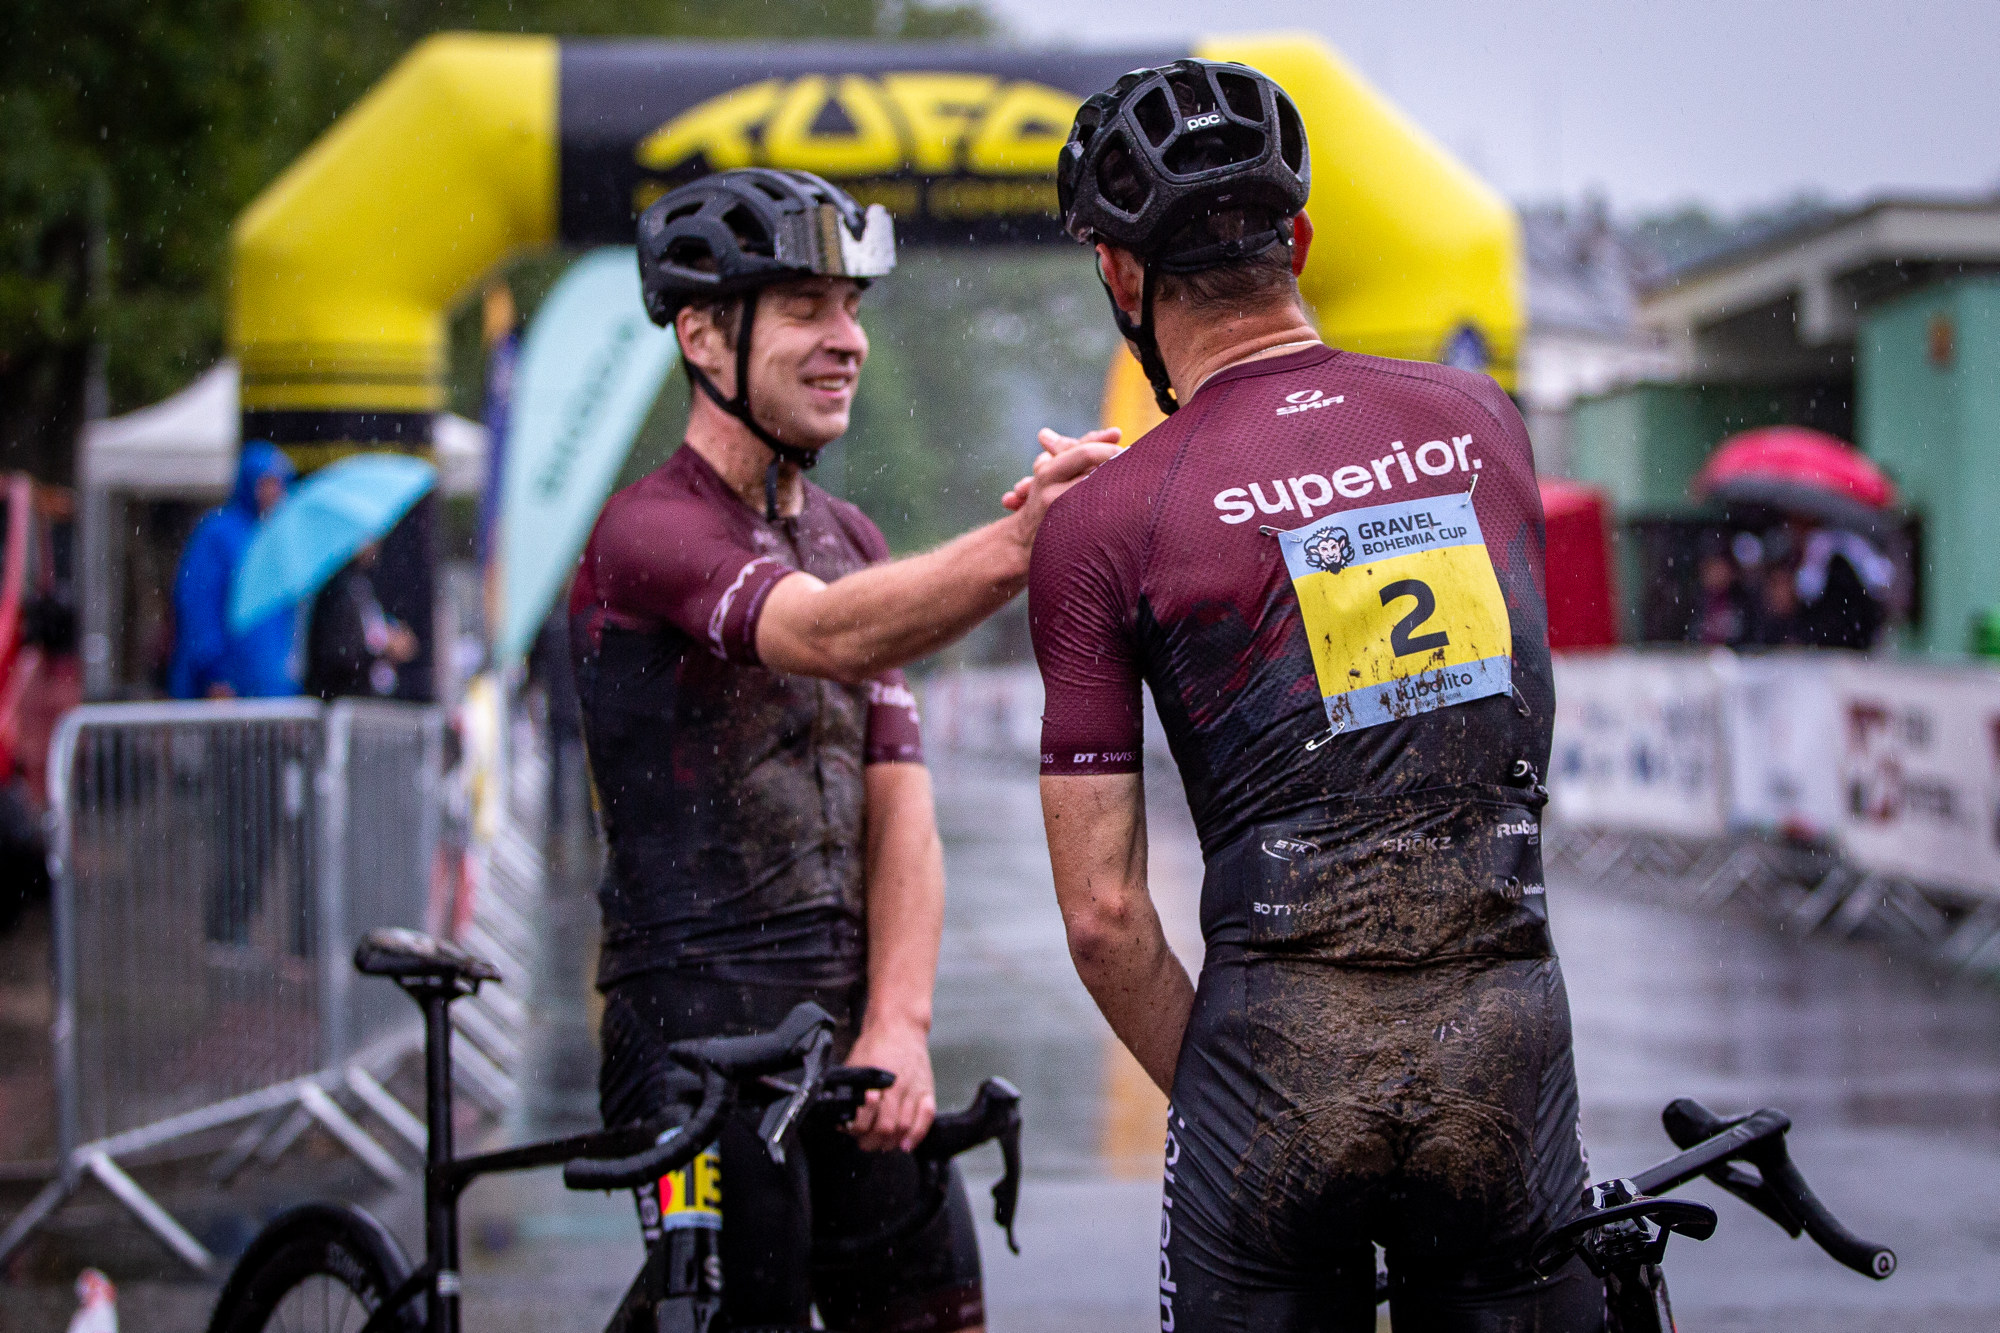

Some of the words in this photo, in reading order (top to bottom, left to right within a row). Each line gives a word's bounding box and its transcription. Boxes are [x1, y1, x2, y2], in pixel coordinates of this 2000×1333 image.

[1213, 433, 1482, 525] superior.
[1358, 511, 1442, 540] GRAVEL
[1362, 531, 1436, 556] BOHEMIA
[1438, 526, 1468, 540] CUP
[1378, 578, 1450, 658] 2
[1073, 753, 1098, 763] DT
